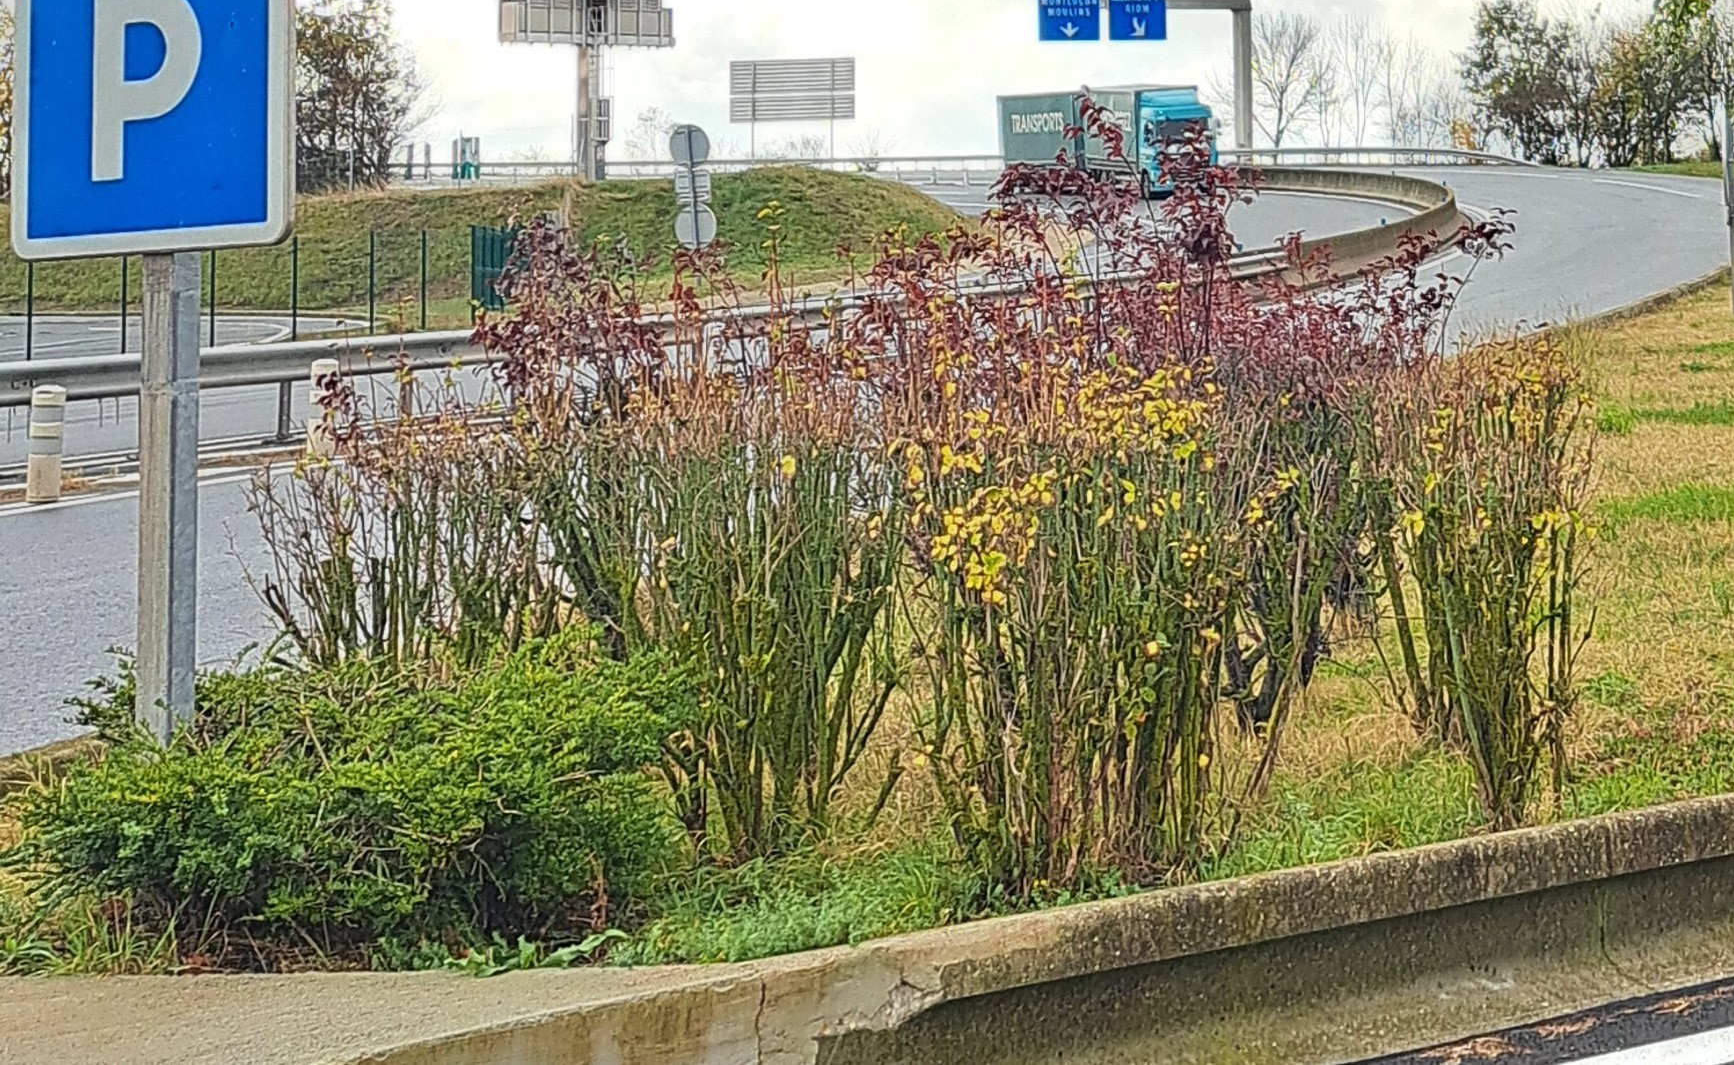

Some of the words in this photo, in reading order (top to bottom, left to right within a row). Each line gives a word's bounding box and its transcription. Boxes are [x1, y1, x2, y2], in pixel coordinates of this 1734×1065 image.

[1048, 8, 1090, 17] MOULINS
[1125, 4, 1150, 13] RIOM
[1011, 112, 1064, 134] TRANSPORTS
